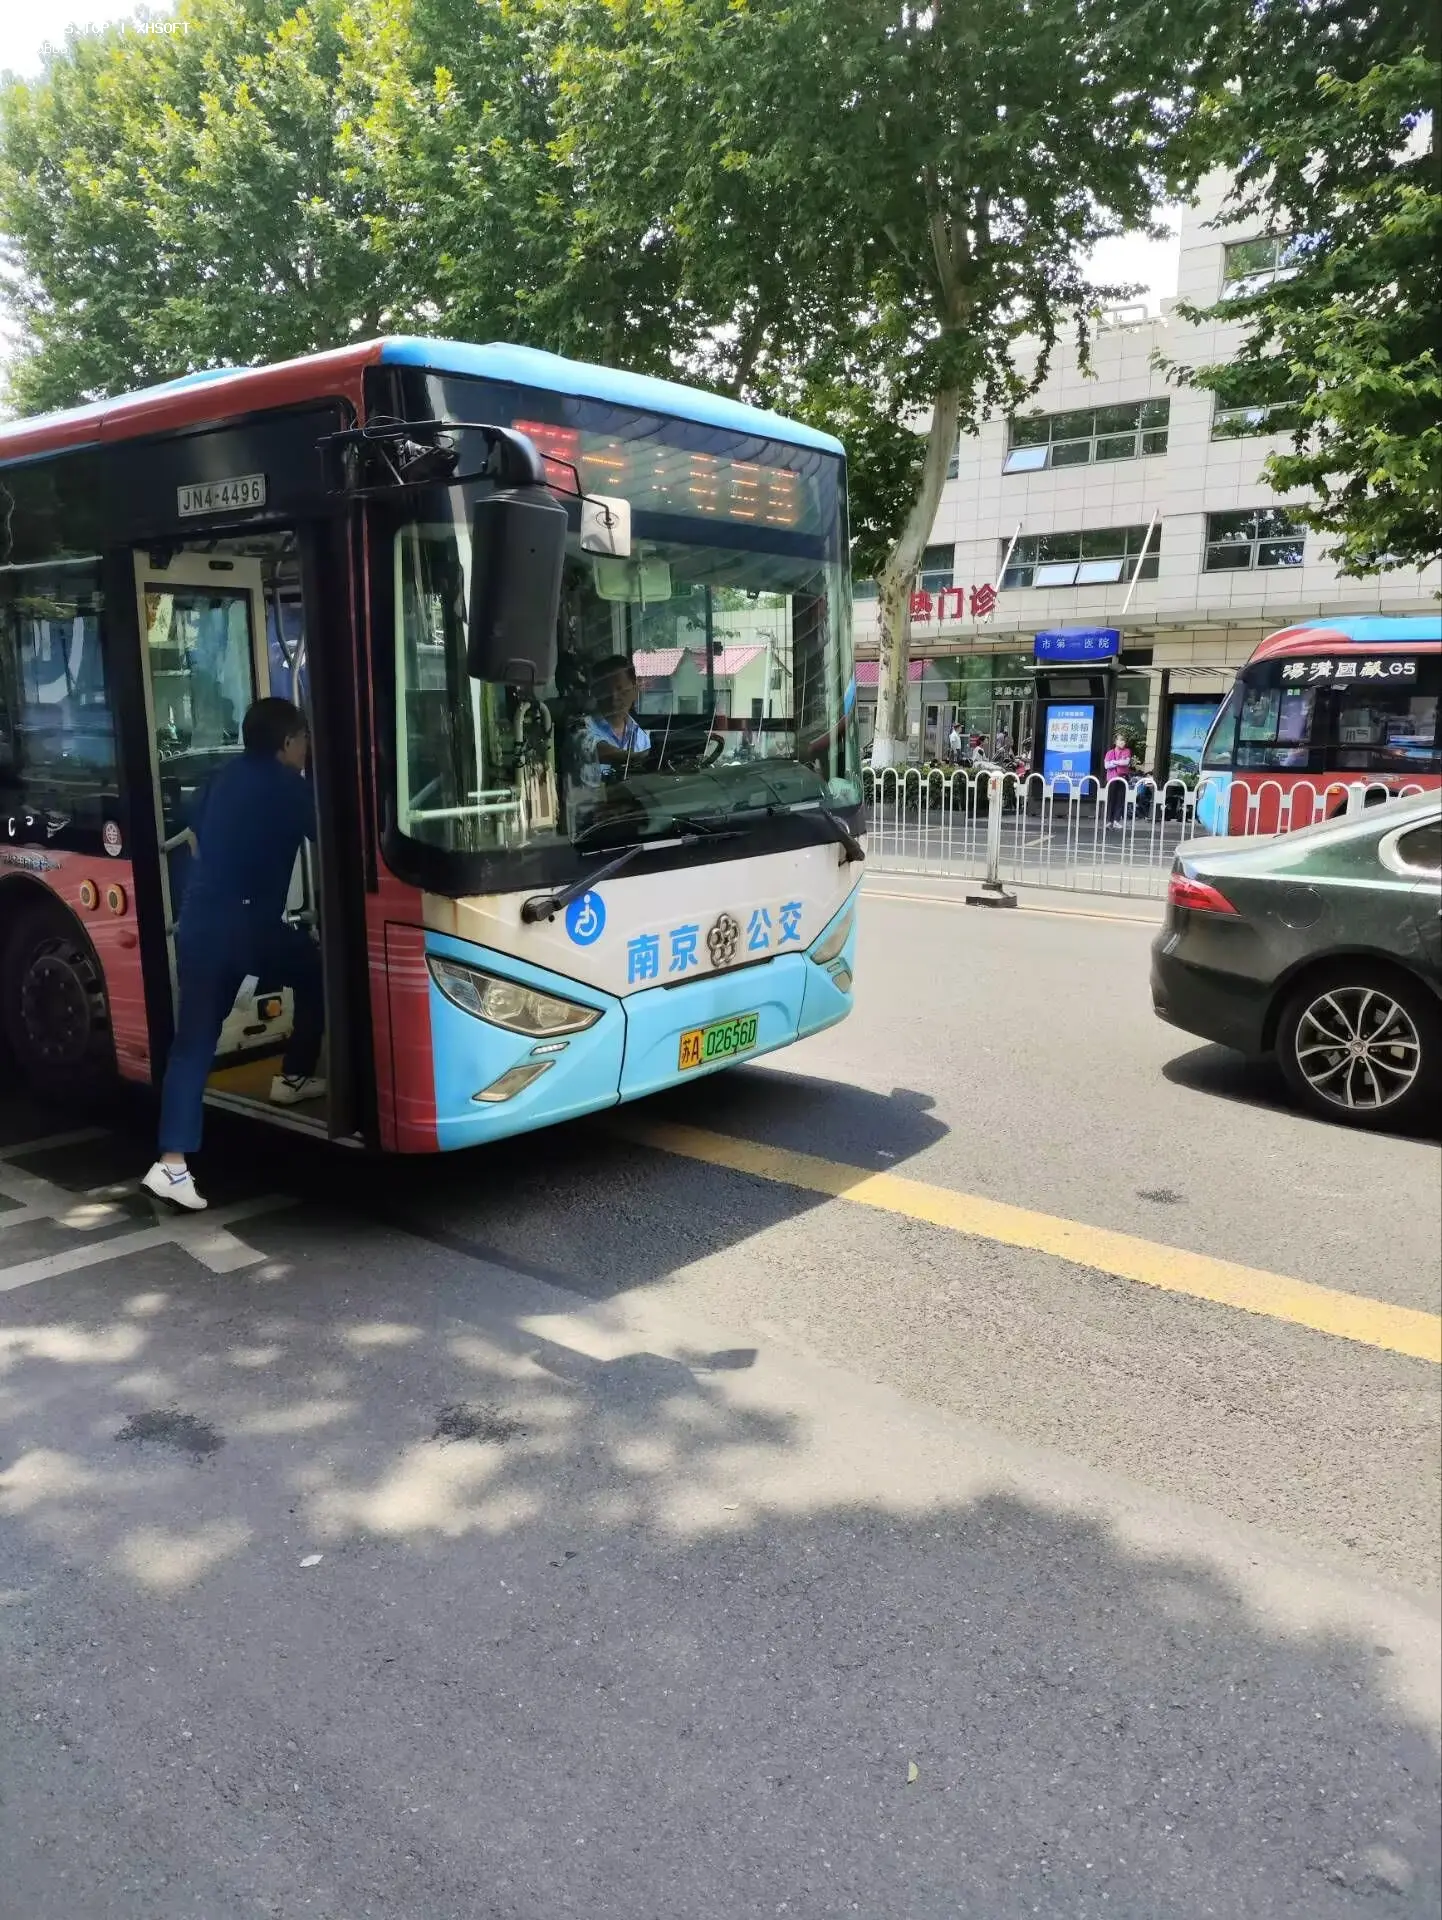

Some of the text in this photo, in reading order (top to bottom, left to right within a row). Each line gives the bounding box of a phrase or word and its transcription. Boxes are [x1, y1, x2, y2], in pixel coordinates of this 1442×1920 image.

[183, 480, 260, 511] JN4-4496
[1041, 637, 1111, 650] 市第一医院
[626, 901, 803, 985] 南京 公交
